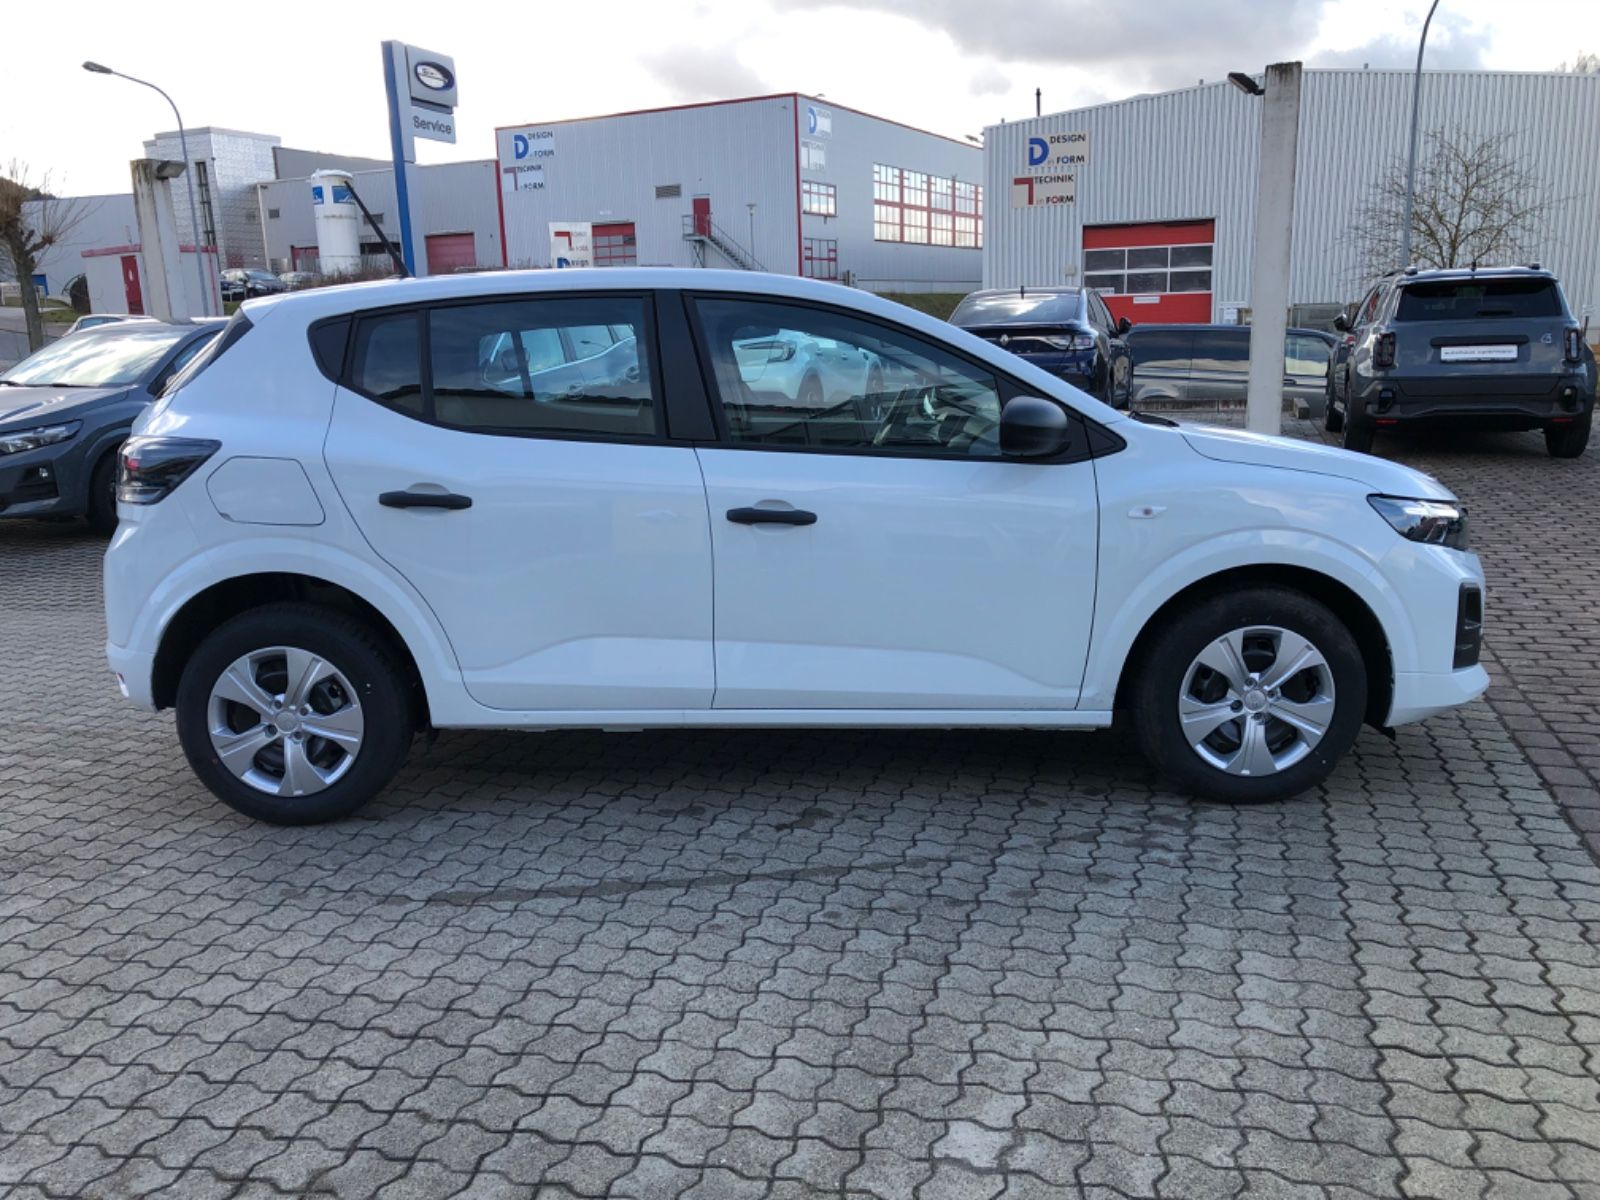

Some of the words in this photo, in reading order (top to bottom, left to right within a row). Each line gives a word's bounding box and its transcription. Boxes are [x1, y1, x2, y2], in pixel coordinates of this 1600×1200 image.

[413, 115, 452, 134] Service
[528, 131, 553, 140] DESIGN
[1049, 134, 1086, 144] DESIGN
[1056, 154, 1085, 164] FORM
[1034, 174, 1074, 184] TECHNIK
[1045, 195, 1074, 204] FORM
